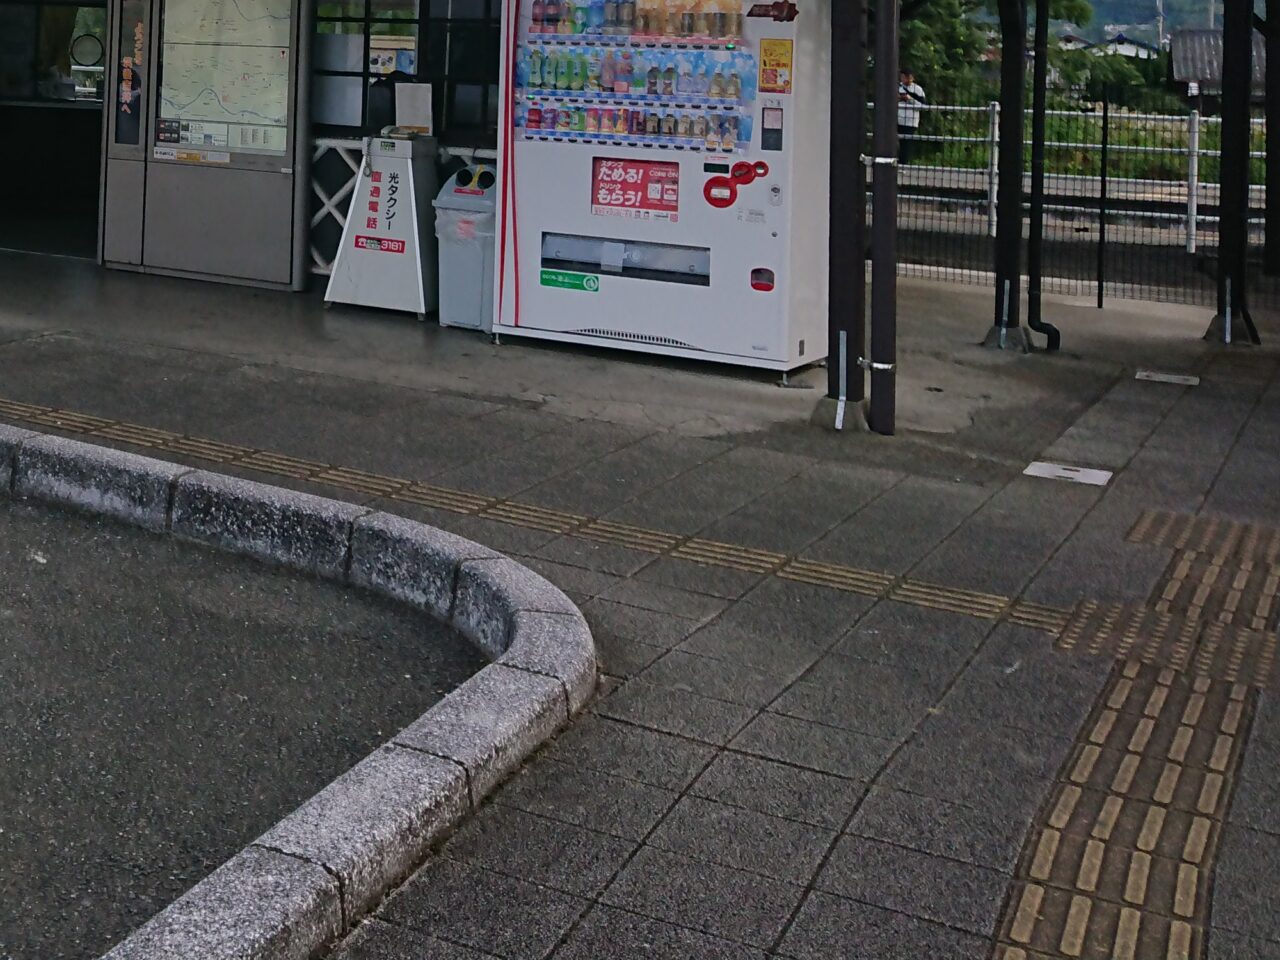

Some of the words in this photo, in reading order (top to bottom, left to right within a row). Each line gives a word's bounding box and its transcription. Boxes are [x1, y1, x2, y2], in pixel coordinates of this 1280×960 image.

[385, 171, 399, 231] 光タクシー
[381, 240, 402, 251] 3181
